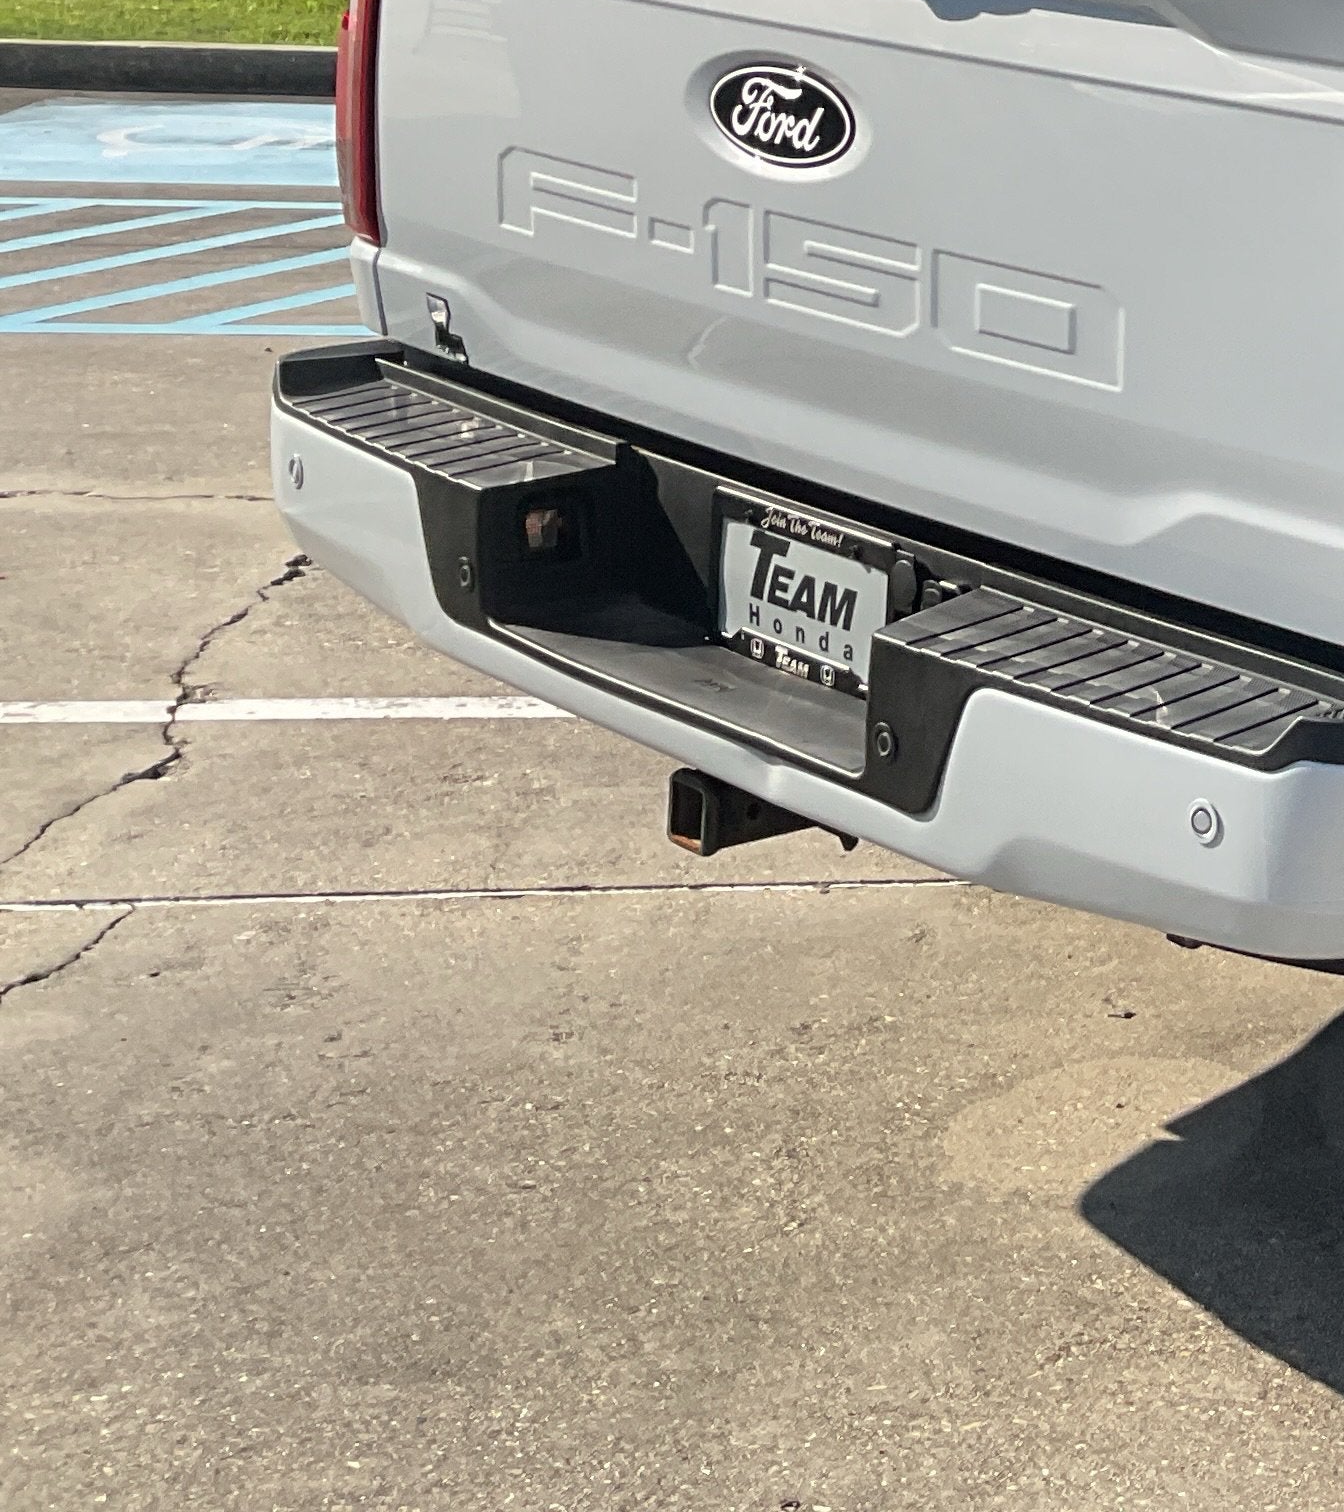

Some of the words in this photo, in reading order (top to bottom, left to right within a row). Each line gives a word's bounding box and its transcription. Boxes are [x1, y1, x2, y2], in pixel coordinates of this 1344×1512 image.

[732, 76, 822, 153] Ford
[497, 146, 1125, 392] F-150
[761, 507, 786, 529] Join
[787, 514, 808, 536] The
[808, 521, 844, 548] Team!
[750, 530, 858, 631] TEAM
[749, 603, 853, 662] Honda
[775, 645, 810, 679] TEAM
